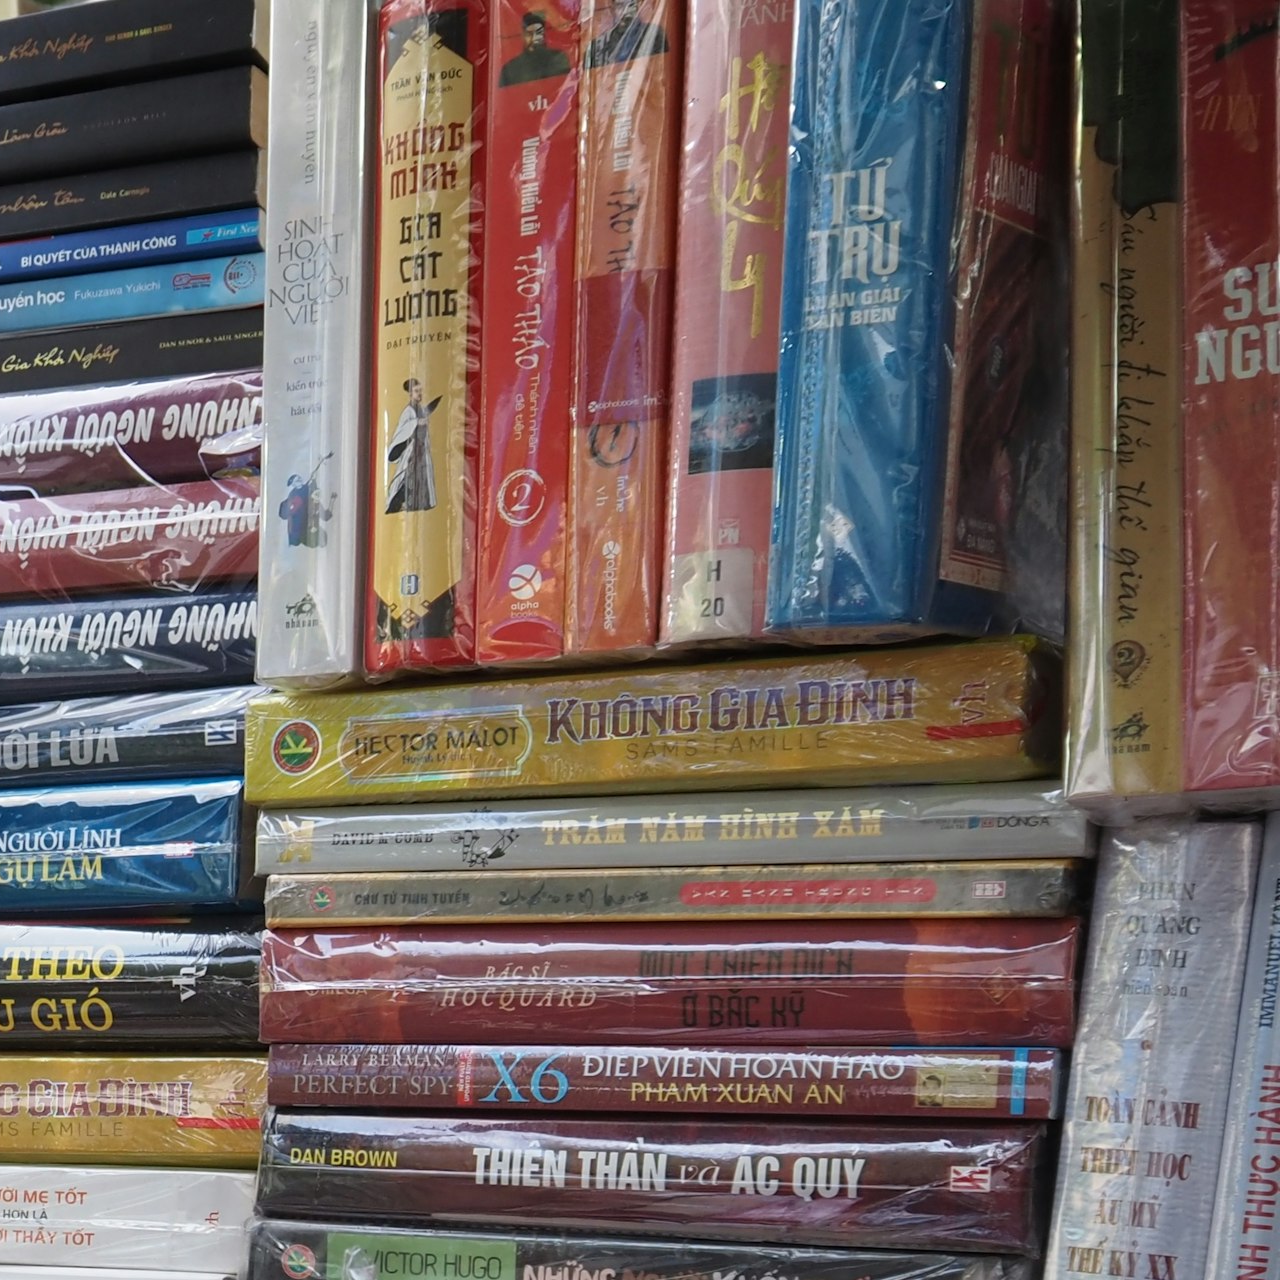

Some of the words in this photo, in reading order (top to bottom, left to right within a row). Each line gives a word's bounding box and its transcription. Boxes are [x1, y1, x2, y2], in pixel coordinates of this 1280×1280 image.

[399, 211, 442, 246] GIA
[141, 232, 178, 252] CÔNG
[36, 287, 66, 309] học
[74, 285, 124, 301] Fukuzawa
[125, 279, 162, 296] Yukichi
[0, 354, 32, 374] Gia
[159, 341, 177, 350] DAN
[212, 335, 236, 344] SAUL
[706, 560, 722, 583] H
[511, 599, 540, 612] alpha
[700, 596, 725, 619] 20
[445, 725, 520, 750] MALOT
[543, 692, 700, 745] KHÔNG
[707, 684, 788, 734] GIA
[795, 674, 918, 729] ĐÌNH
[712, 729, 830, 754] FAMILLE
[331, 831, 375, 847] DAVID
[718, 807, 800, 841] HÌNH
[1126, 916, 1202, 938] QUANG
[1, 943, 126, 982] THEO
[30, 987, 115, 1033] GIÓ
[439, 986, 598, 1012] HOCQUARD
[301, 1053, 360, 1068] LARRY
[367, 1053, 447, 1068] BERMAN
[293, 1073, 401, 1096] PERFECT
[408, 1073, 454, 1097] SPY
[479, 1048, 571, 1105] X6
[27, 1077, 93, 1119] GIA
[96, 1076, 194, 1119] ĐÌNH
[30, 1120, 125, 1138] FAMILLE
[289, 1146, 326, 1165] DAN
[330, 1149, 398, 1168] BROWN
[679, 1158, 721, 1187] và
[22, 1188, 50, 1211] MẸ
[54, 1186, 88, 1206] TỐT
[61, 1228, 96, 1247] TỐT
[443, 1252, 502, 1280] HUGO
